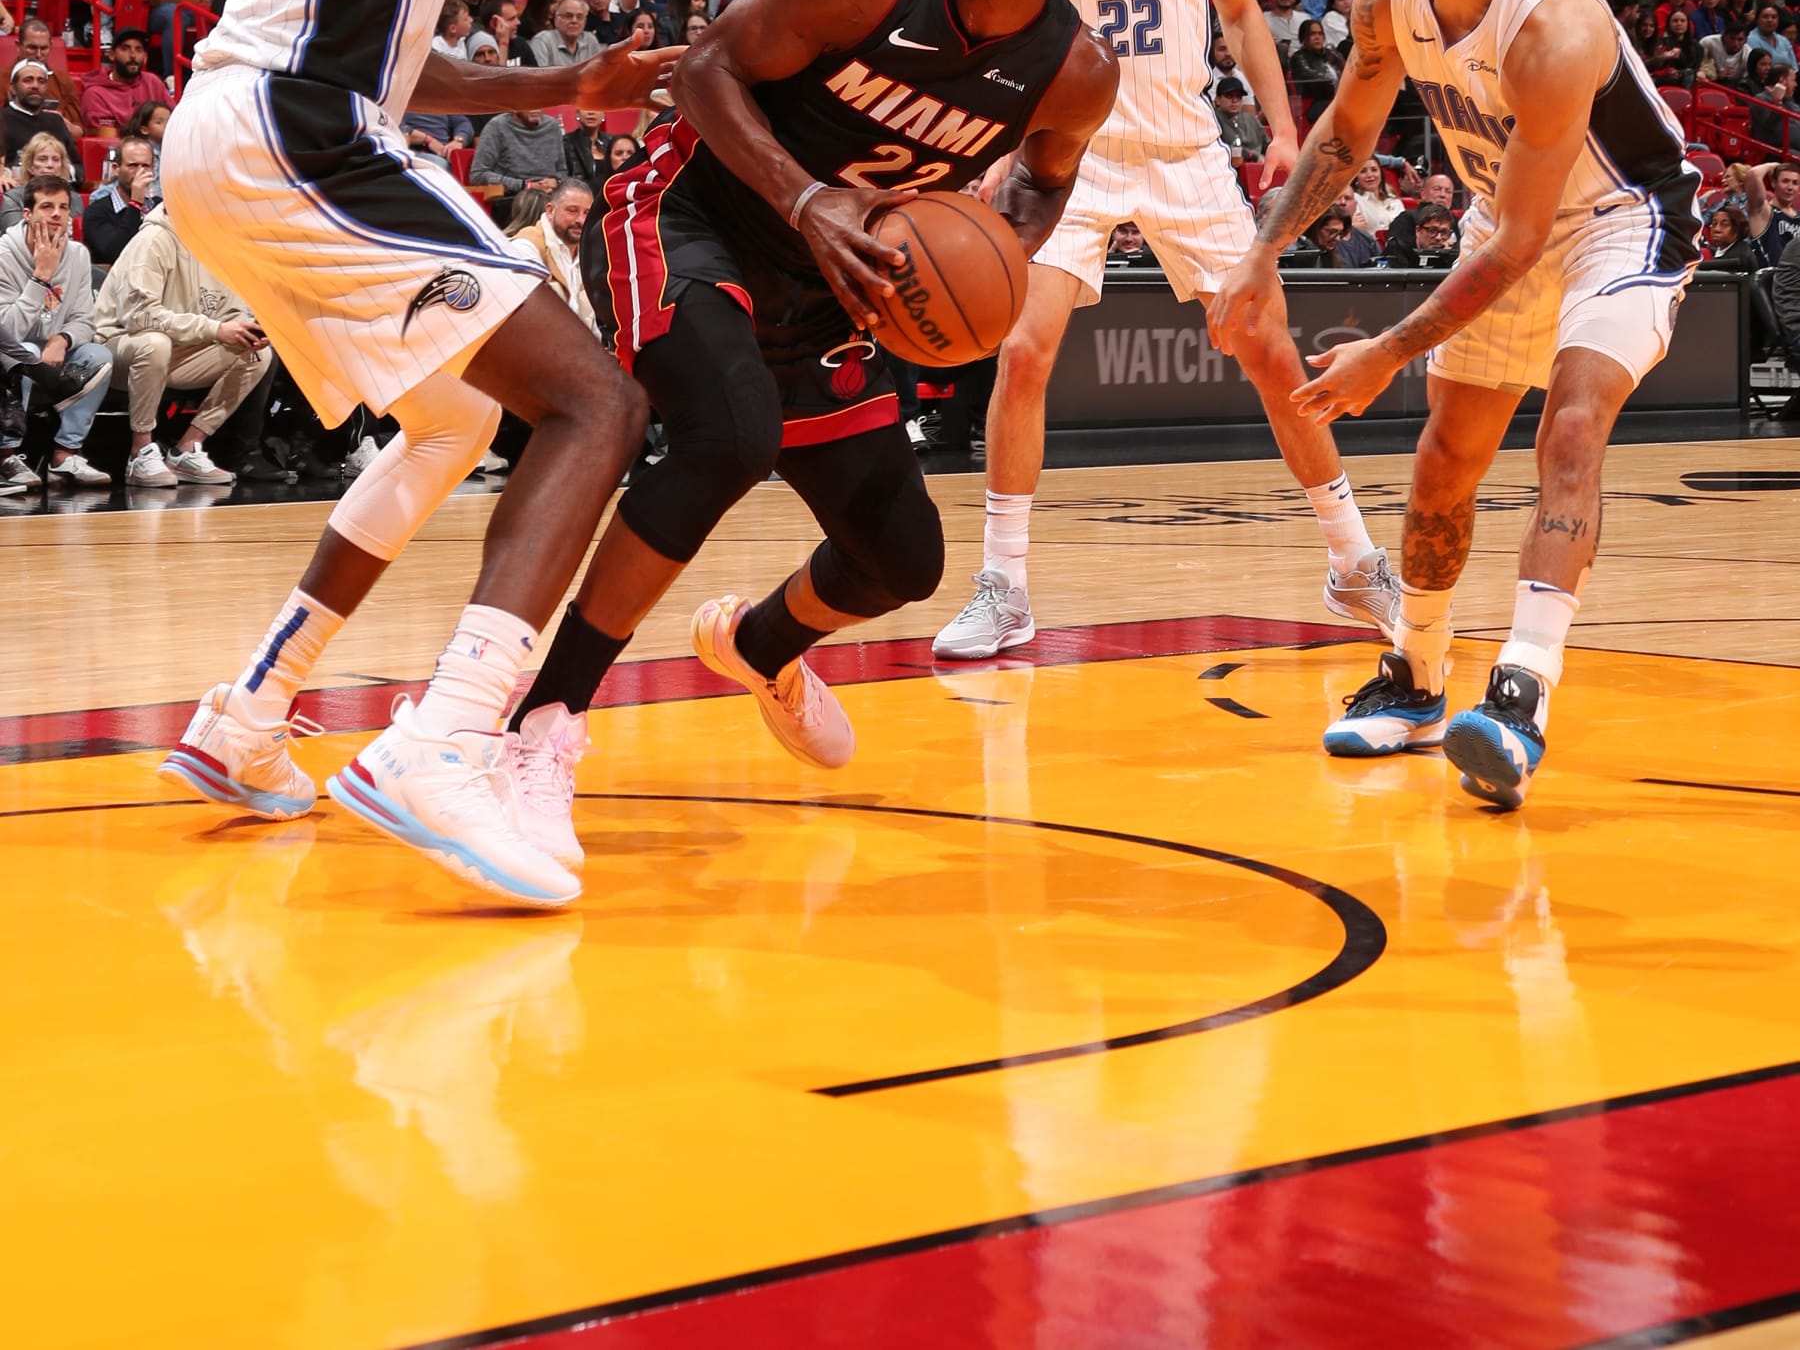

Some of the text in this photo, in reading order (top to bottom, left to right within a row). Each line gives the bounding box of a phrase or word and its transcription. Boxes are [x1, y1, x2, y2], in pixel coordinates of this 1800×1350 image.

[824, 57, 1008, 158] MIAMI
[1457, 145, 1501, 198] 5
[888, 240, 953, 351] Wilson
[1094, 327, 1225, 385] WATCH
